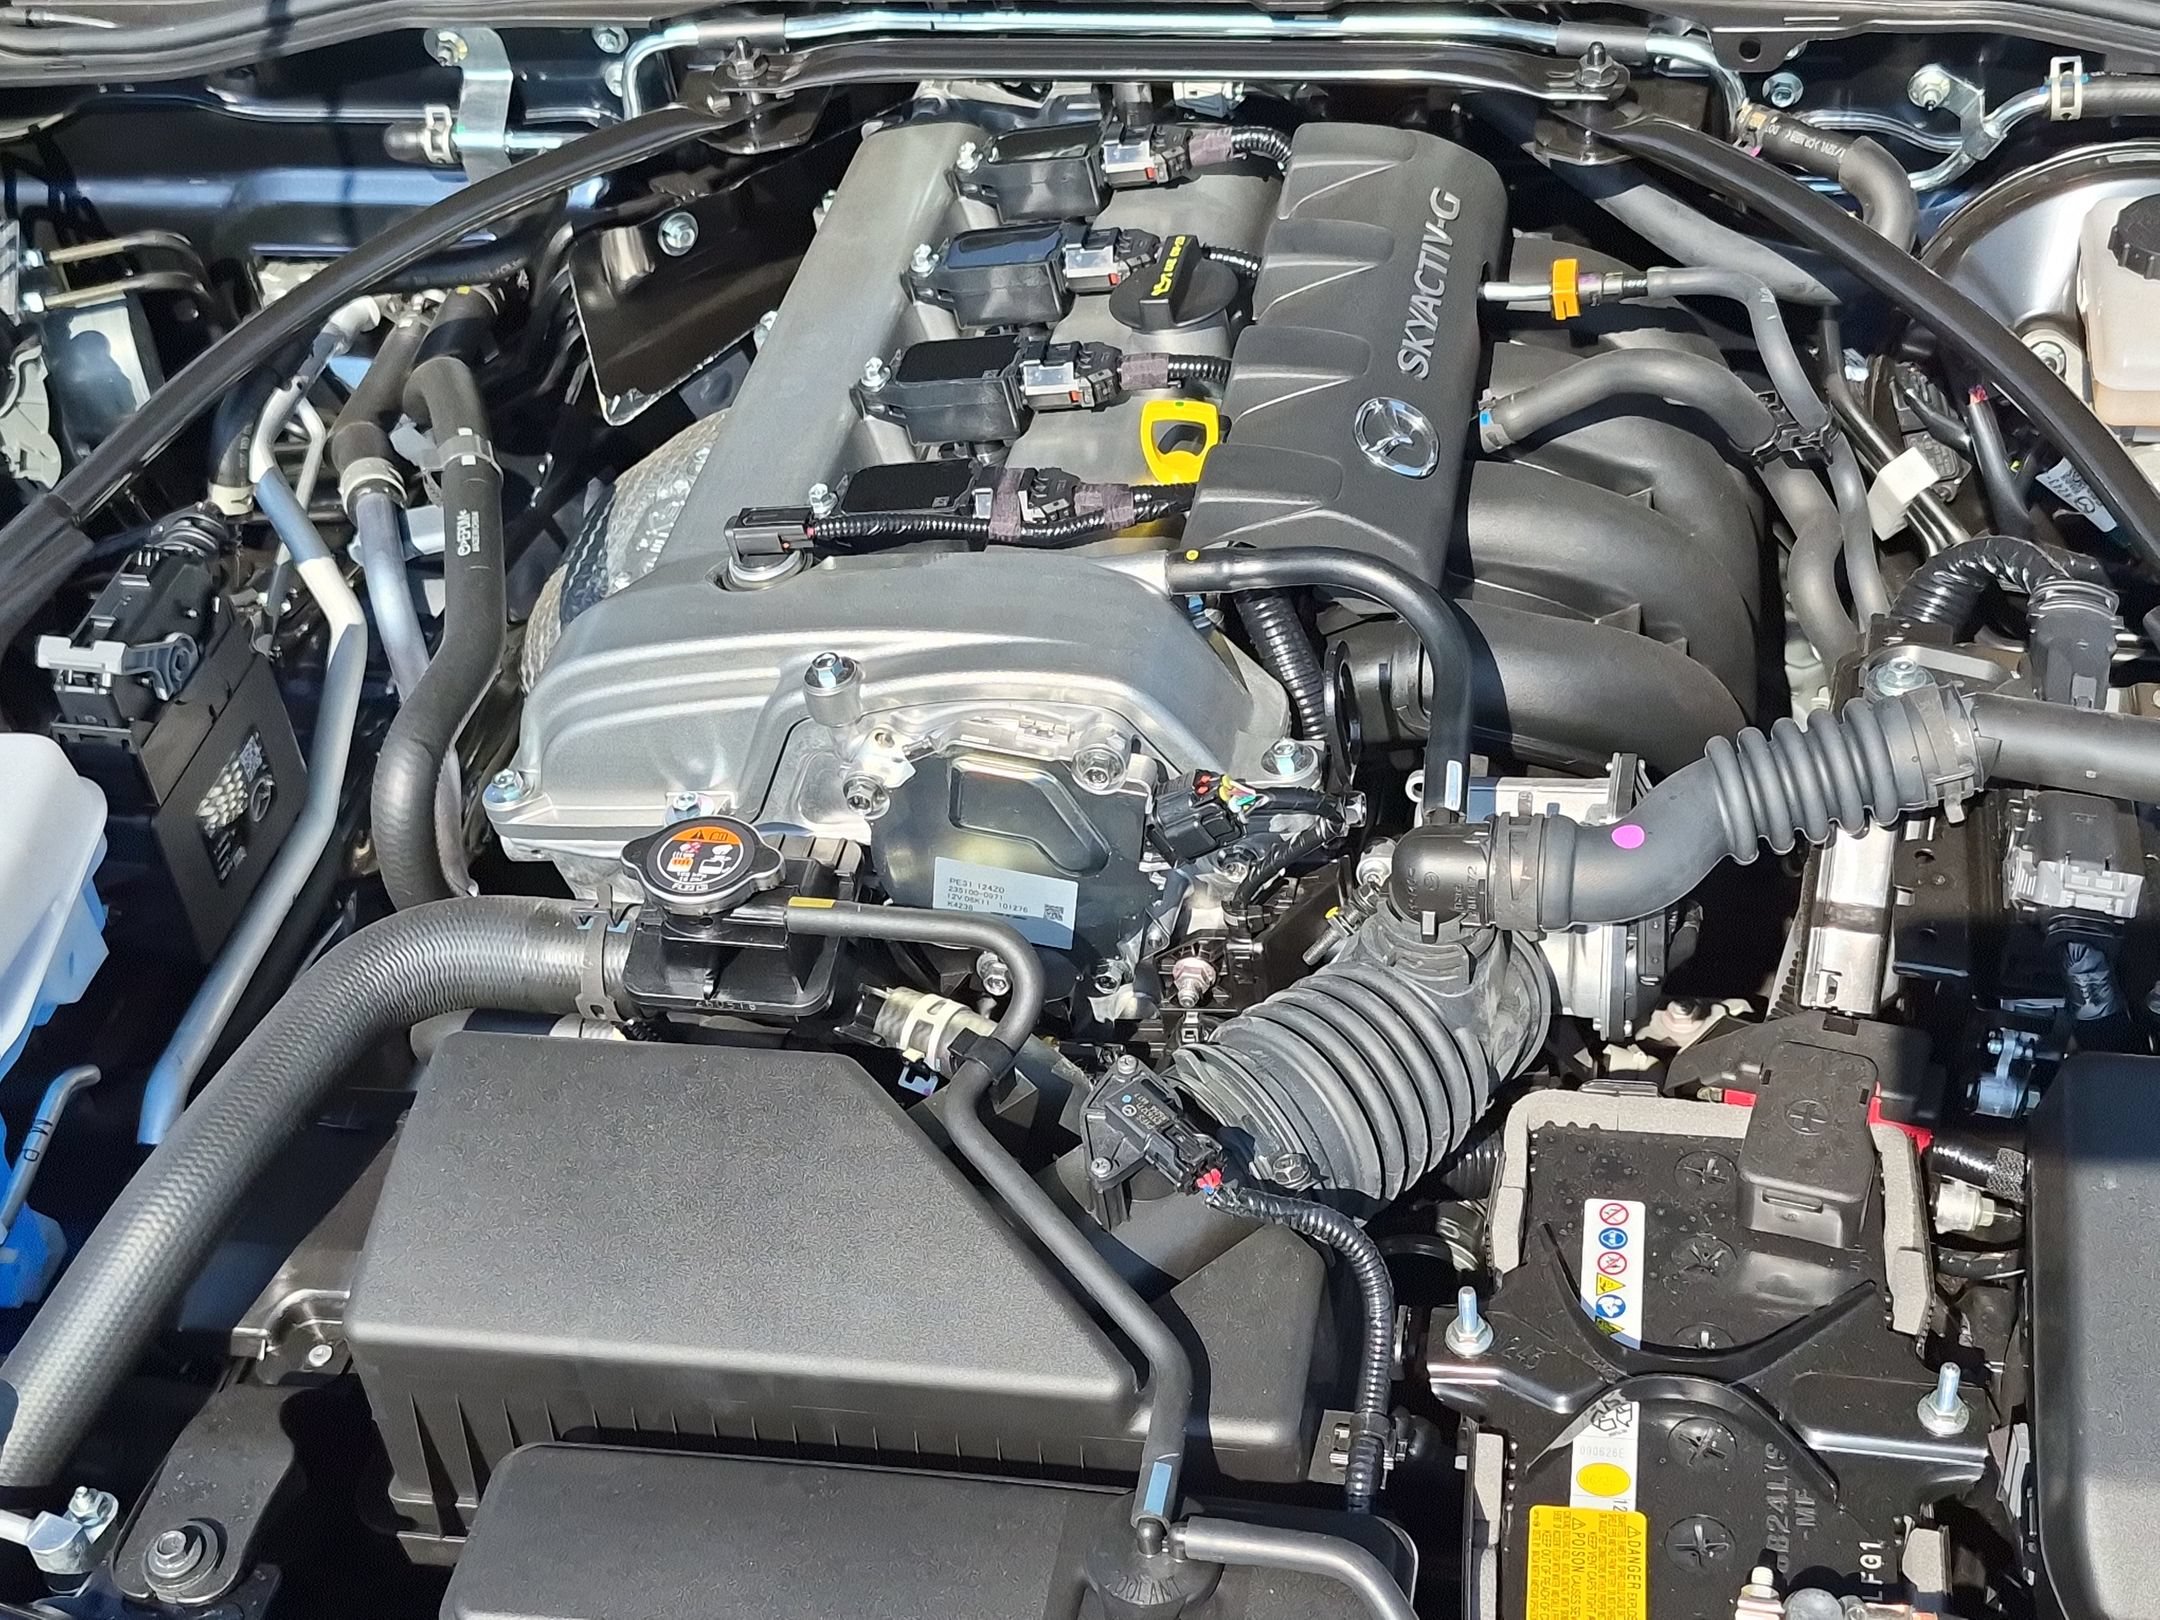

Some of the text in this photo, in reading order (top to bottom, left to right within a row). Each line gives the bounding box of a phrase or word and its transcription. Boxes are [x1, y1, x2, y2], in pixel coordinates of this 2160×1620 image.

[1397, 186, 1461, 381] SKYACTIV-G
[1571, 1532, 1586, 1573] POISON
[1626, 1540, 1642, 1590] DANGER
[1570, 1574, 1582, 1605] CAUSES
[1586, 1571, 1597, 1591] CAPS
